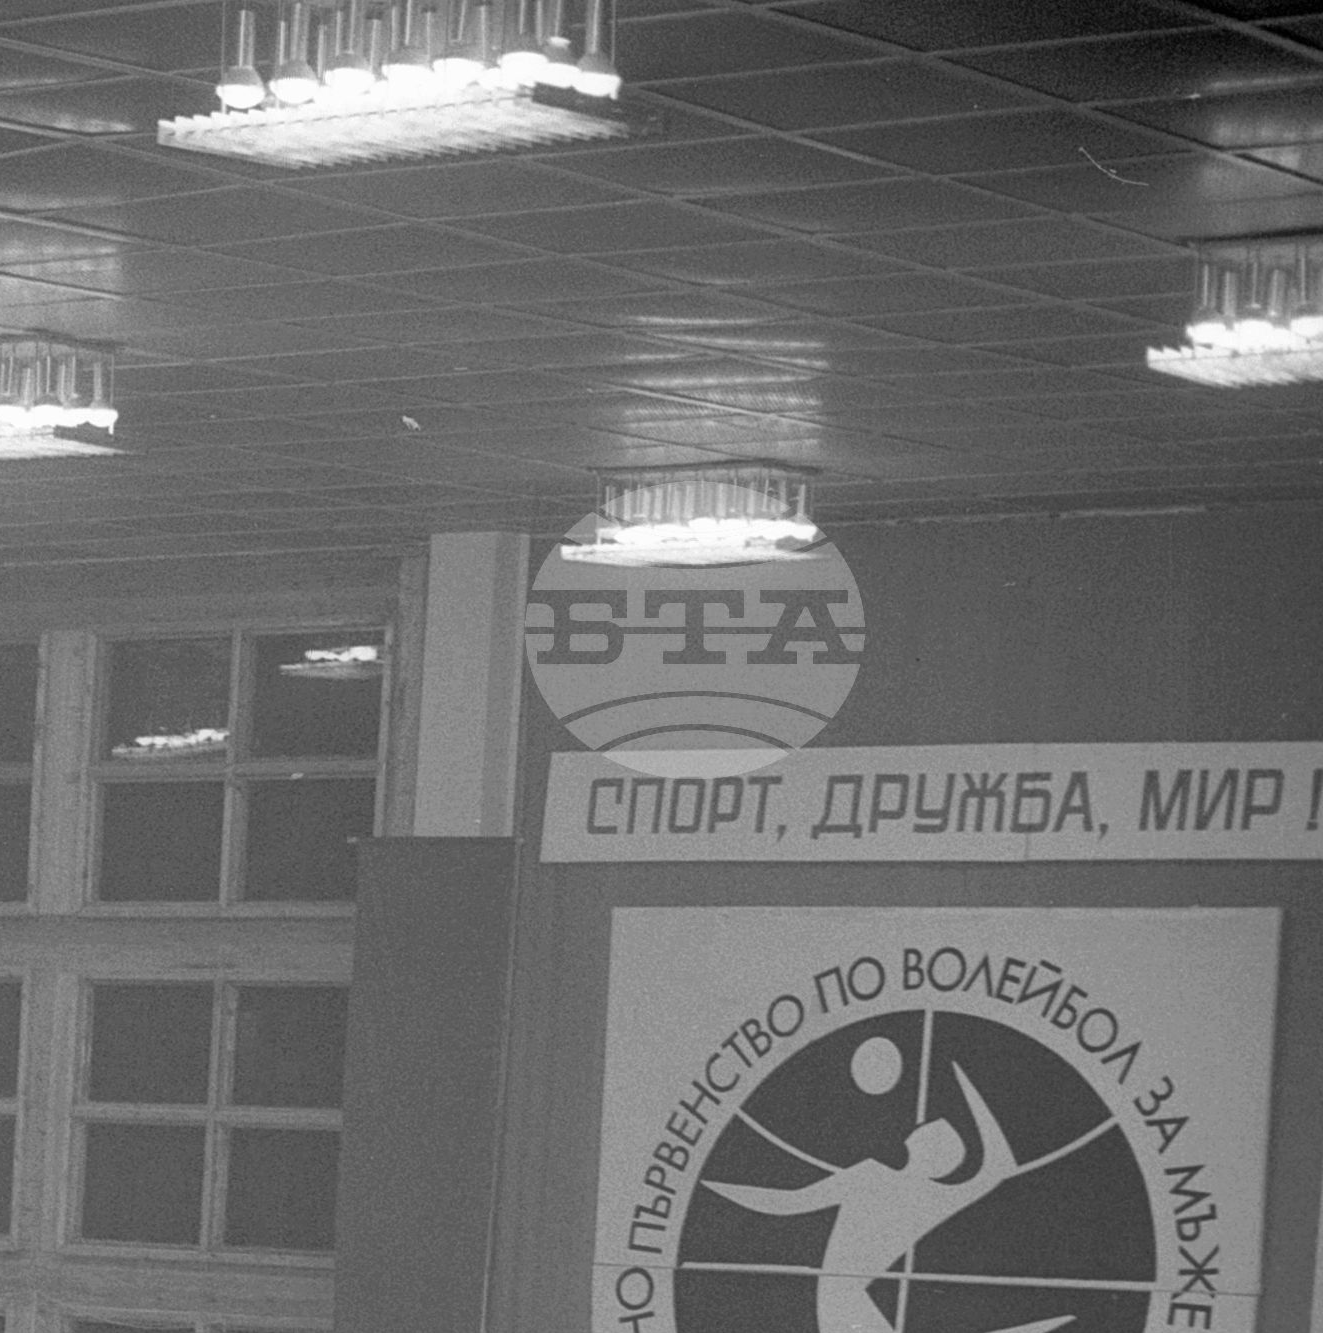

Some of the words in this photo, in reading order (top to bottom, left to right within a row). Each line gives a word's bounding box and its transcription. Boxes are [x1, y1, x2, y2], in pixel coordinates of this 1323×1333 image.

[587, 775, 786, 842] СПОРТ,
[809, 771, 1109, 840] ДРУЖБА,
[628, 994, 805, 1254] ПЪРВЕНСТВО
[813, 956, 886, 1013] ПО
[902, 946, 1142, 1085] ВОЛЕЙБОЛ
[1133, 1075, 1190, 1154] ЗА
[1163, 1164, 1220, 1330] МЪЖЕ
